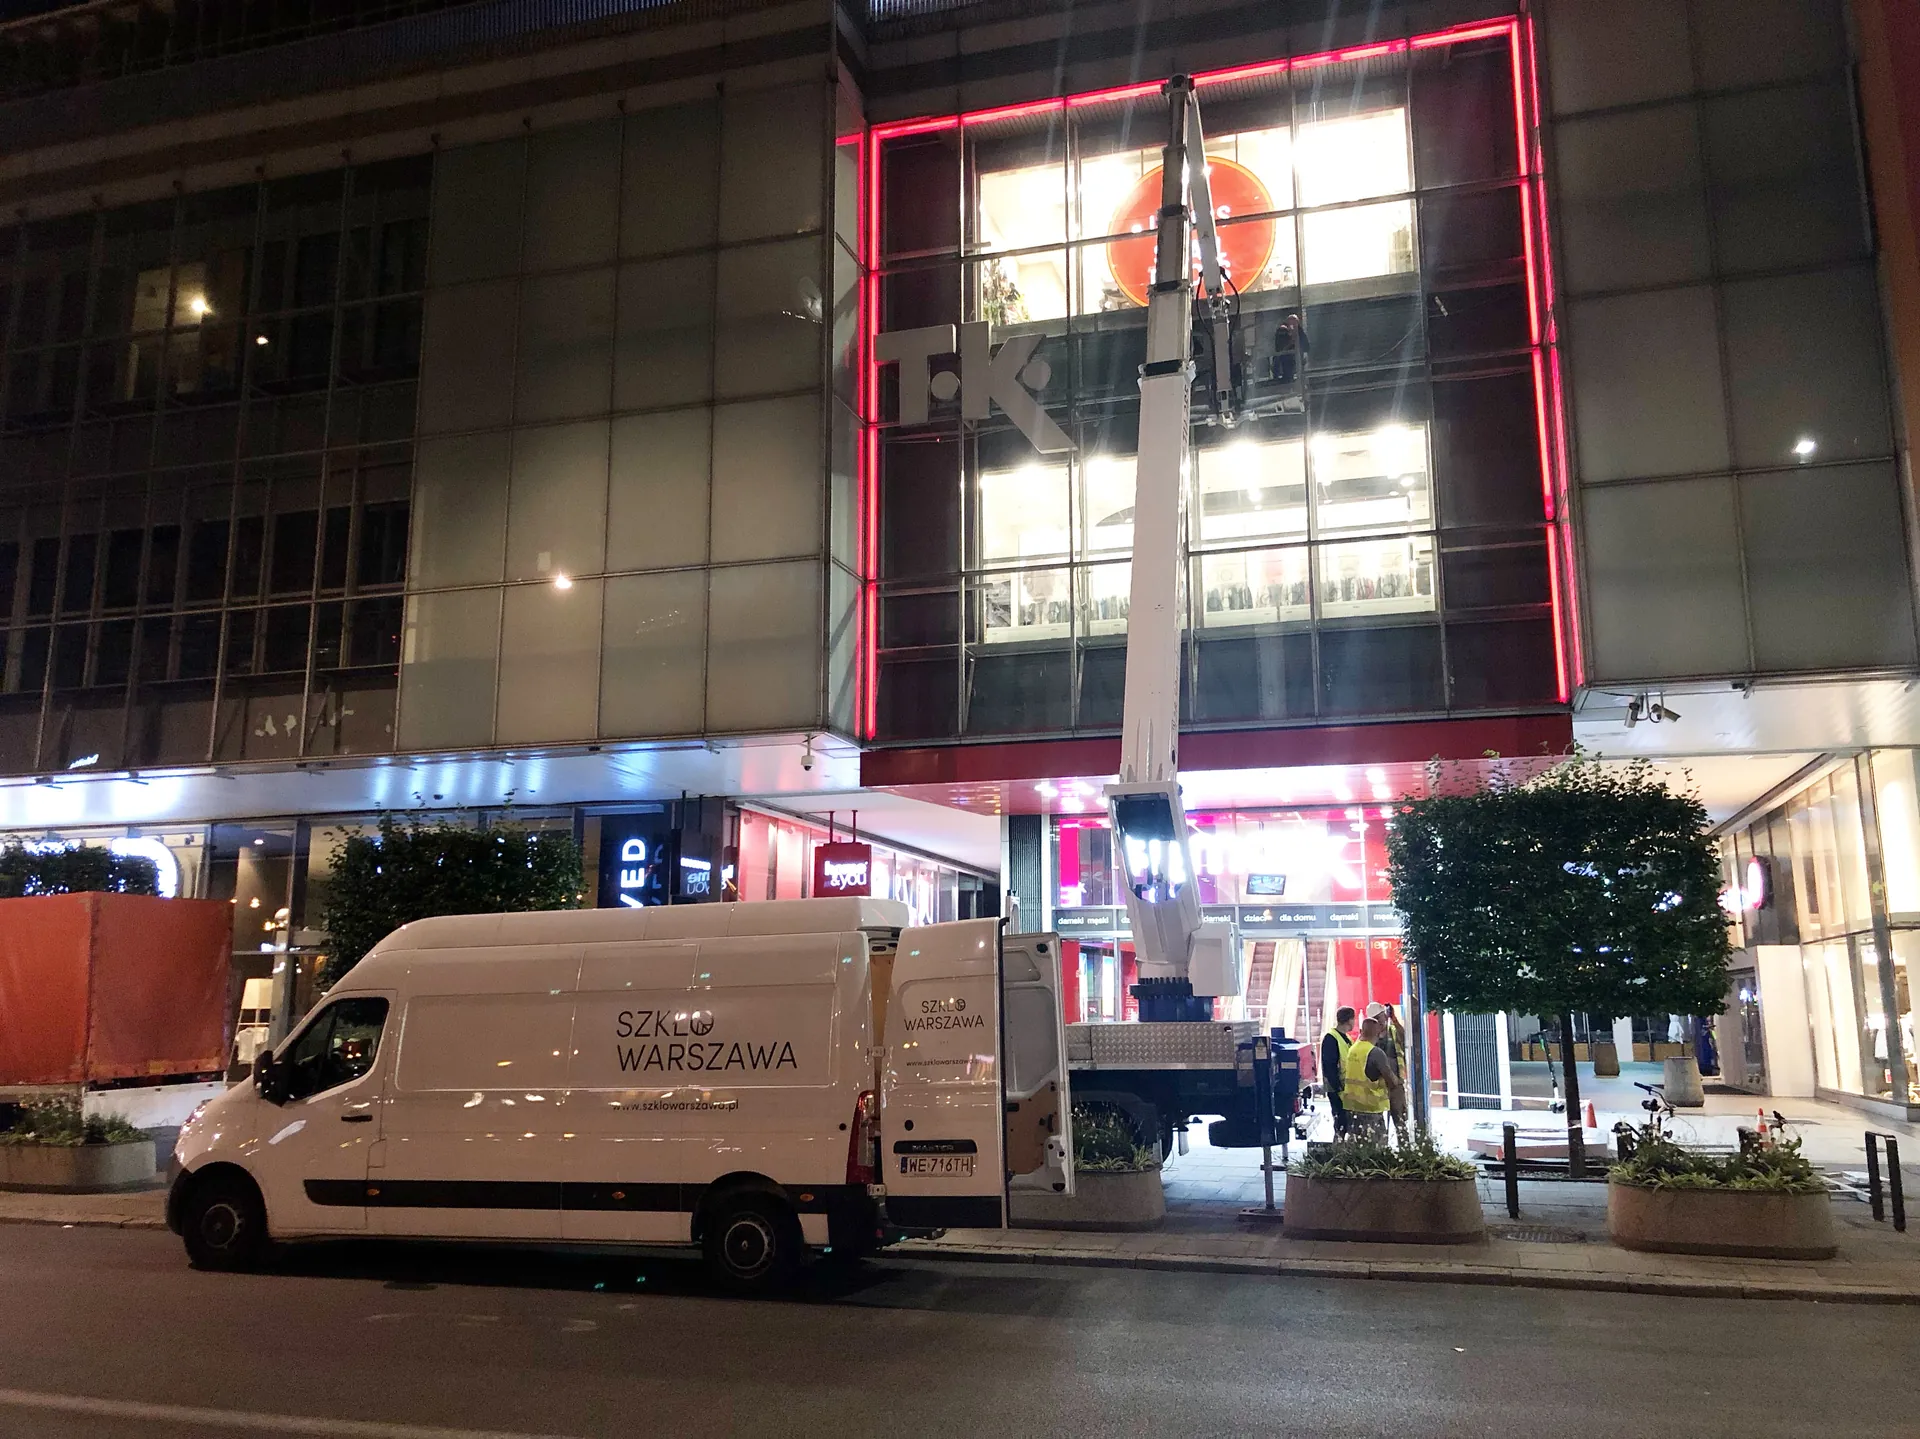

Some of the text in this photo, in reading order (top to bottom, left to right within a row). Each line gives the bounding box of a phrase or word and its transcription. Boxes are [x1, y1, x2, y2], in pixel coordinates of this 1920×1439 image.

[1279, 914, 1292, 922] dla
[1293, 913, 1317, 922] domu
[903, 1014, 985, 1031] WARSZAWA
[617, 1041, 798, 1072] WARSZAWA
[909, 1157, 970, 1172] WE 716TH
